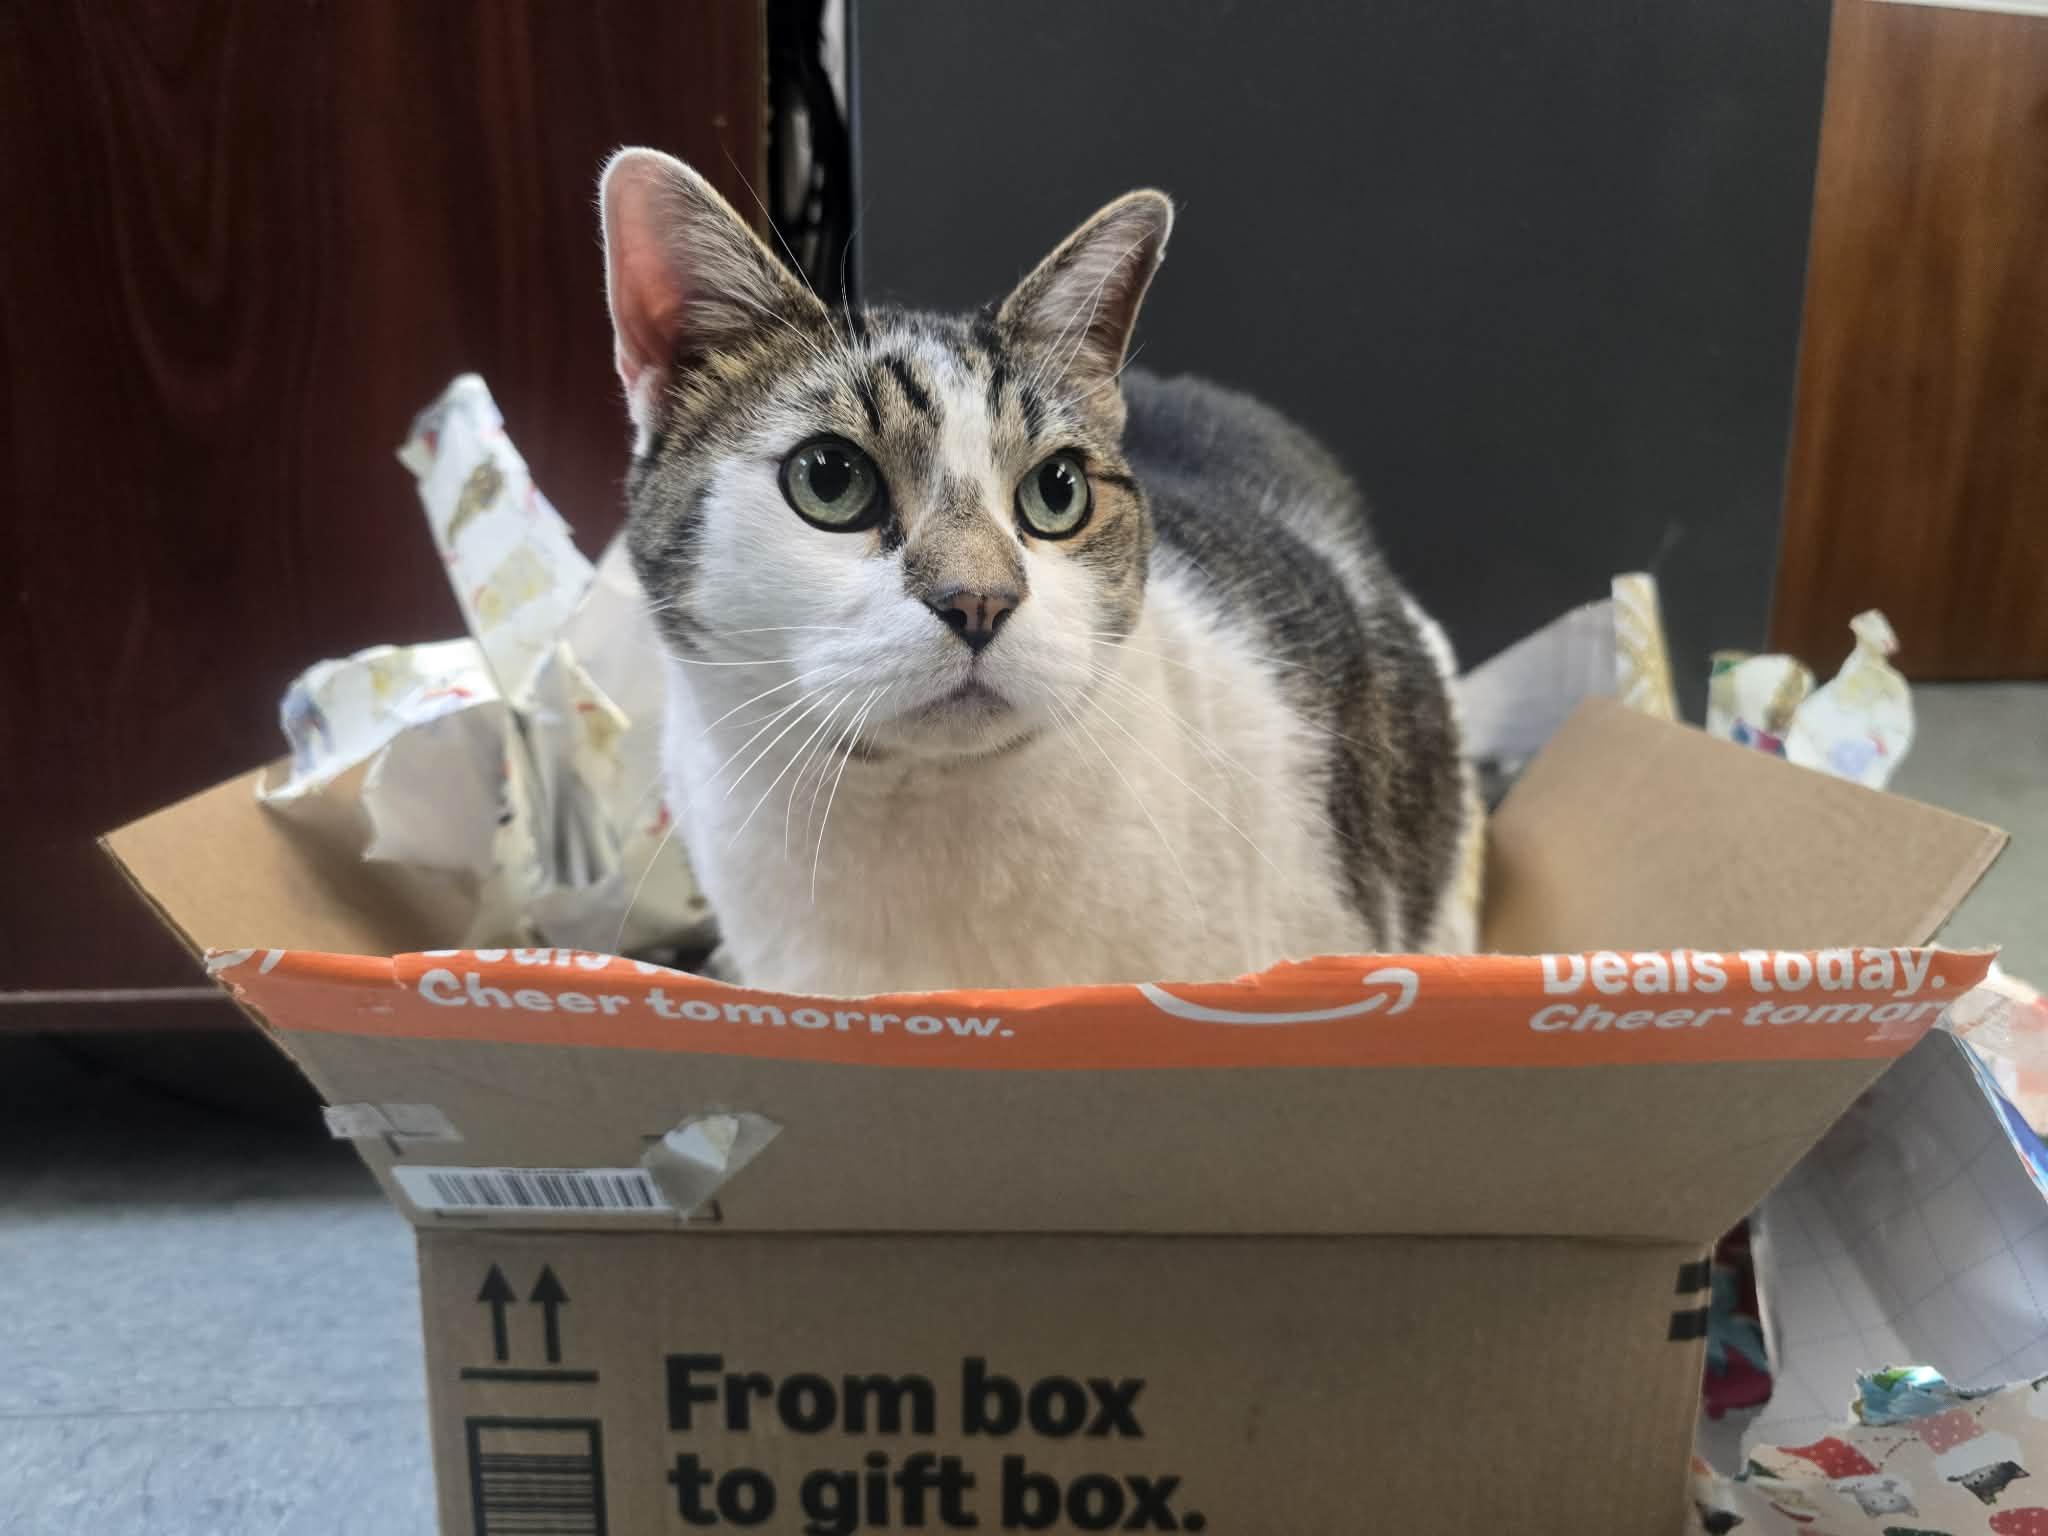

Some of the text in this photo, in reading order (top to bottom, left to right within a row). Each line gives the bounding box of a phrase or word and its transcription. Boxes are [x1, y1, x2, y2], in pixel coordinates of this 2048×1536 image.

[418, 968, 1014, 1037] Cheer tomorrow.
[1541, 948, 1945, 997] Deals today.
[1529, 1003, 1732, 1032] Cheer
[664, 1354, 1144, 1437] From box
[667, 1450, 1208, 1536] to gift box.
